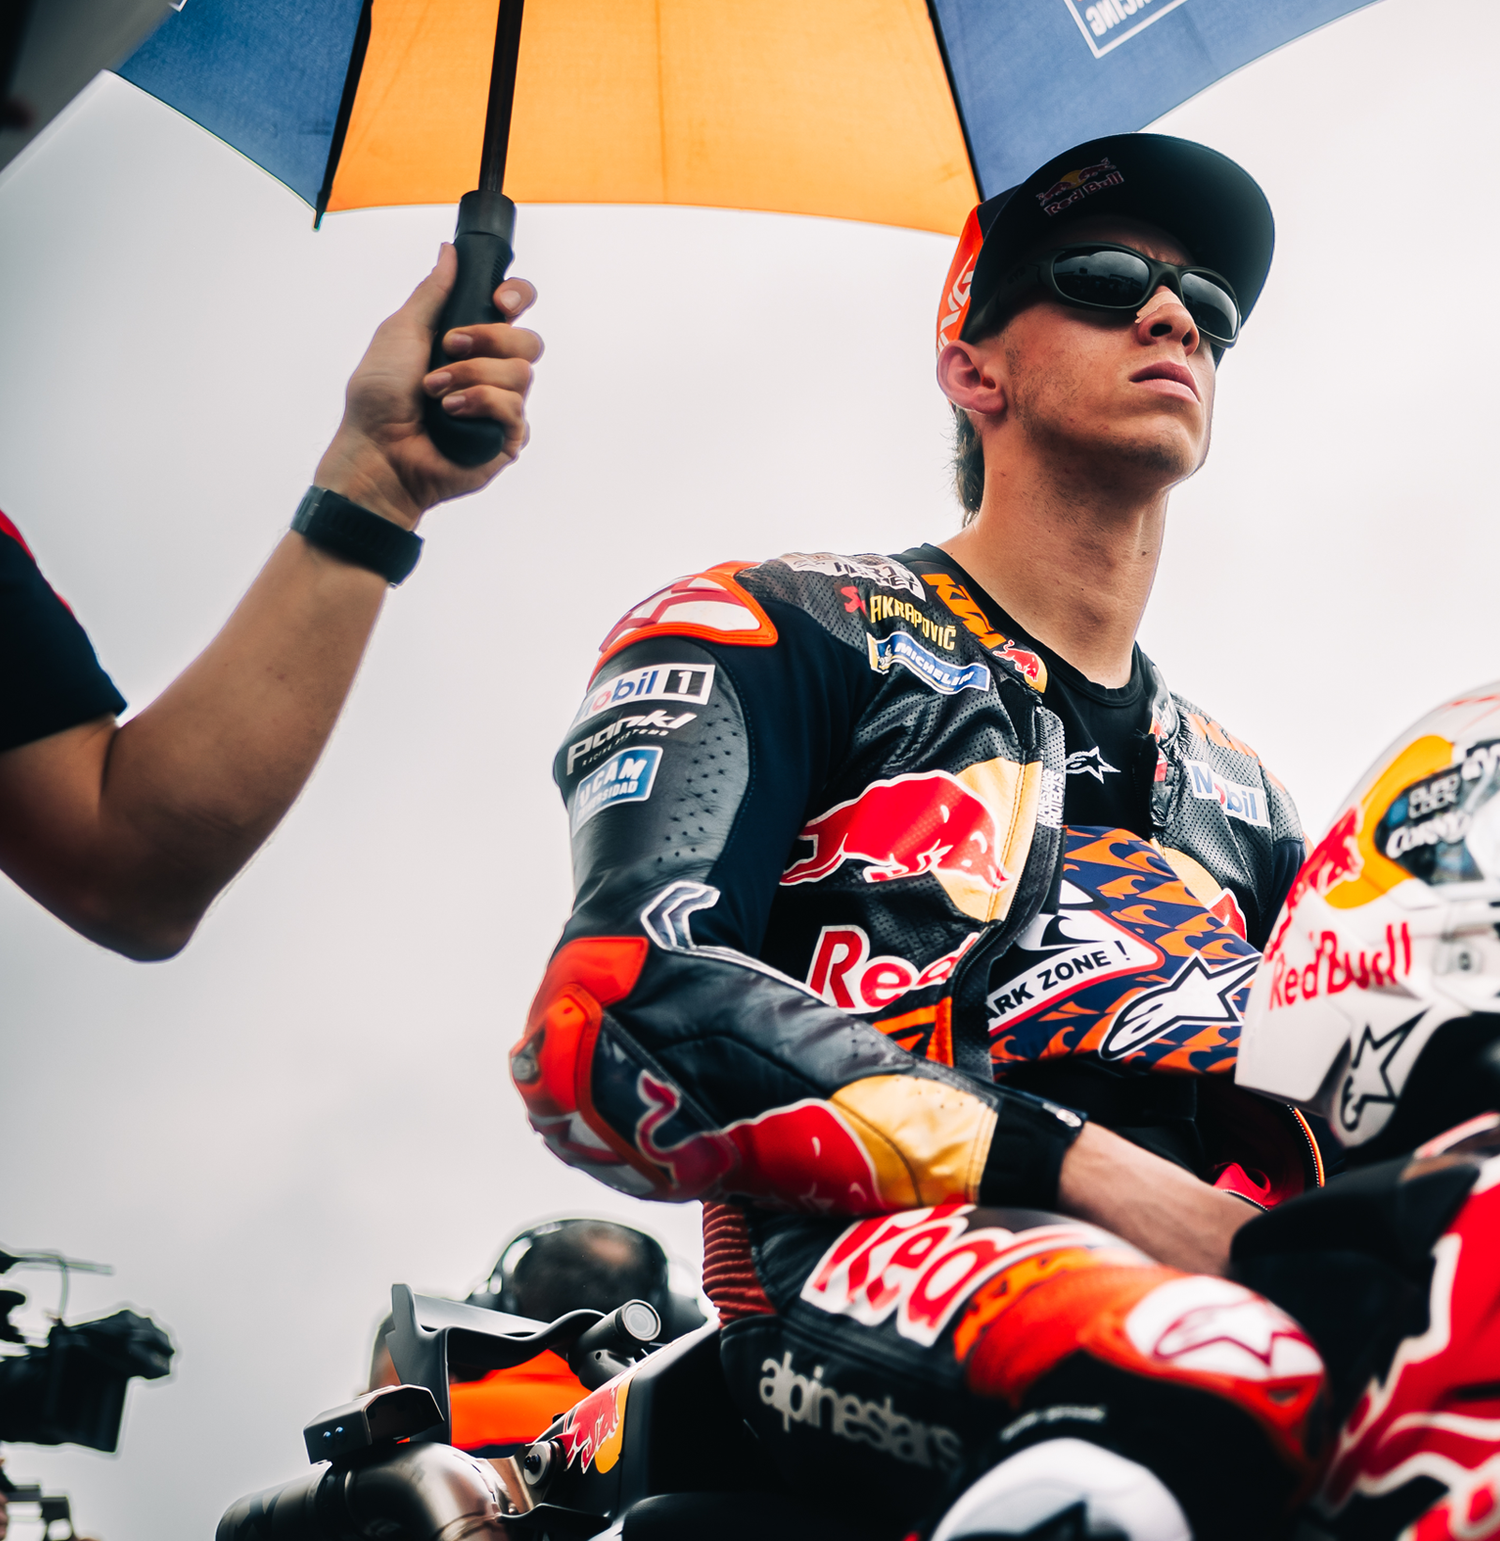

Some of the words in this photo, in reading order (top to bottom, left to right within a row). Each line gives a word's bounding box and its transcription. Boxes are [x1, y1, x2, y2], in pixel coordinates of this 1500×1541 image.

[1043, 188, 1082, 216] Red
[1082, 171, 1125, 196] Bull
[869, 594, 957, 651] AKRAPOVIČ
[894, 642, 975, 686] MICHELIN
[579, 757, 648, 808] UCAM
[1036, 950, 1113, 991] ZONE
[1268, 930, 1323, 1012] Red
[1320, 921, 1412, 995] Bull
[758, 1350, 965, 1470] alpinestars
